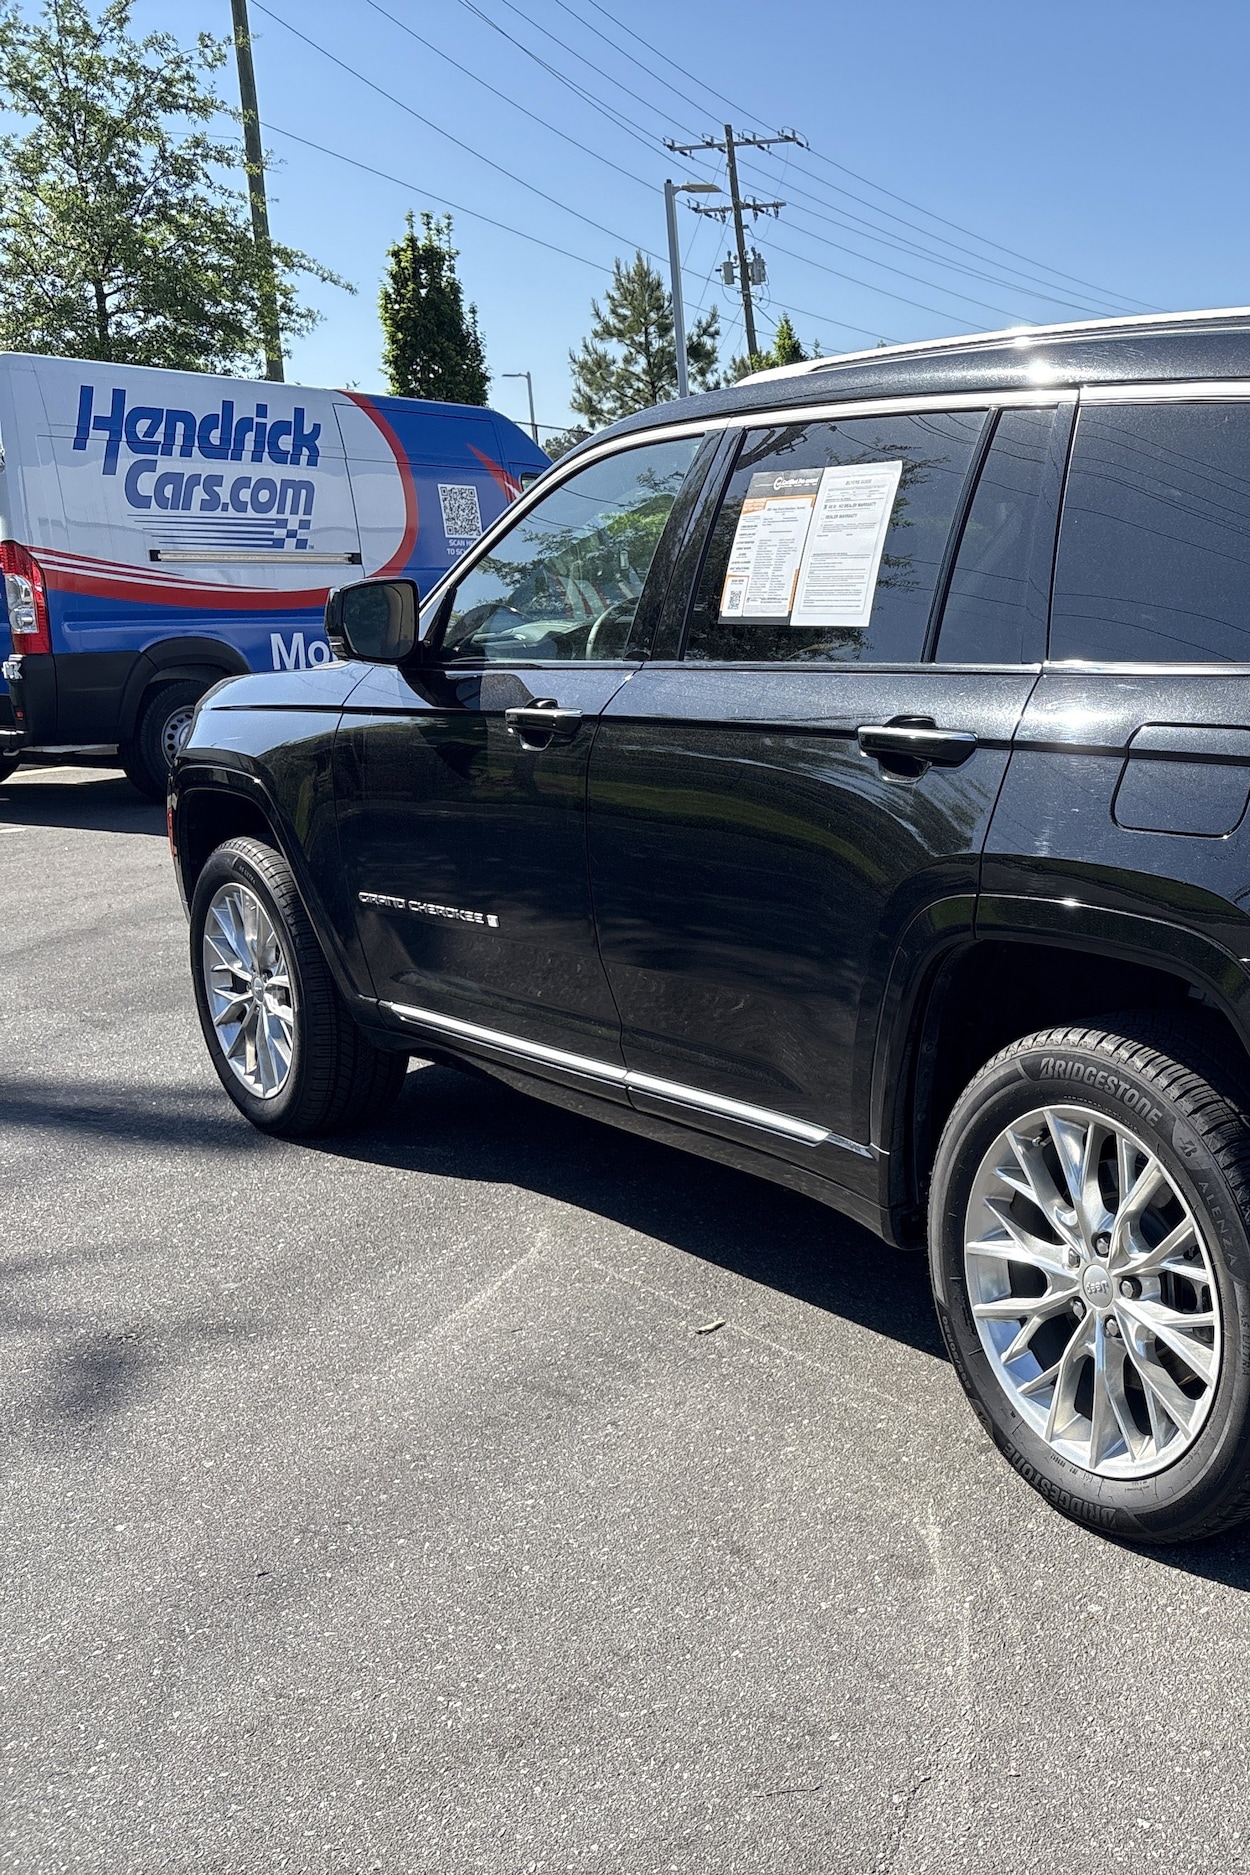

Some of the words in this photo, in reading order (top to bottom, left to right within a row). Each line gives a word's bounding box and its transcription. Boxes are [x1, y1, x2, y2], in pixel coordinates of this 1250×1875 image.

[73, 385, 321, 475] Hendrick
[125, 459, 315, 514] Cars.com
[358, 891, 405, 909] GRAND
[408, 900, 485, 925] CHEROKEE
[1039, 1057, 1163, 1127] BRIDGESTONE
[1198, 1181, 1239, 1267] ALENZA
[1004, 1442, 1117, 1528] BRIDGESTONE
